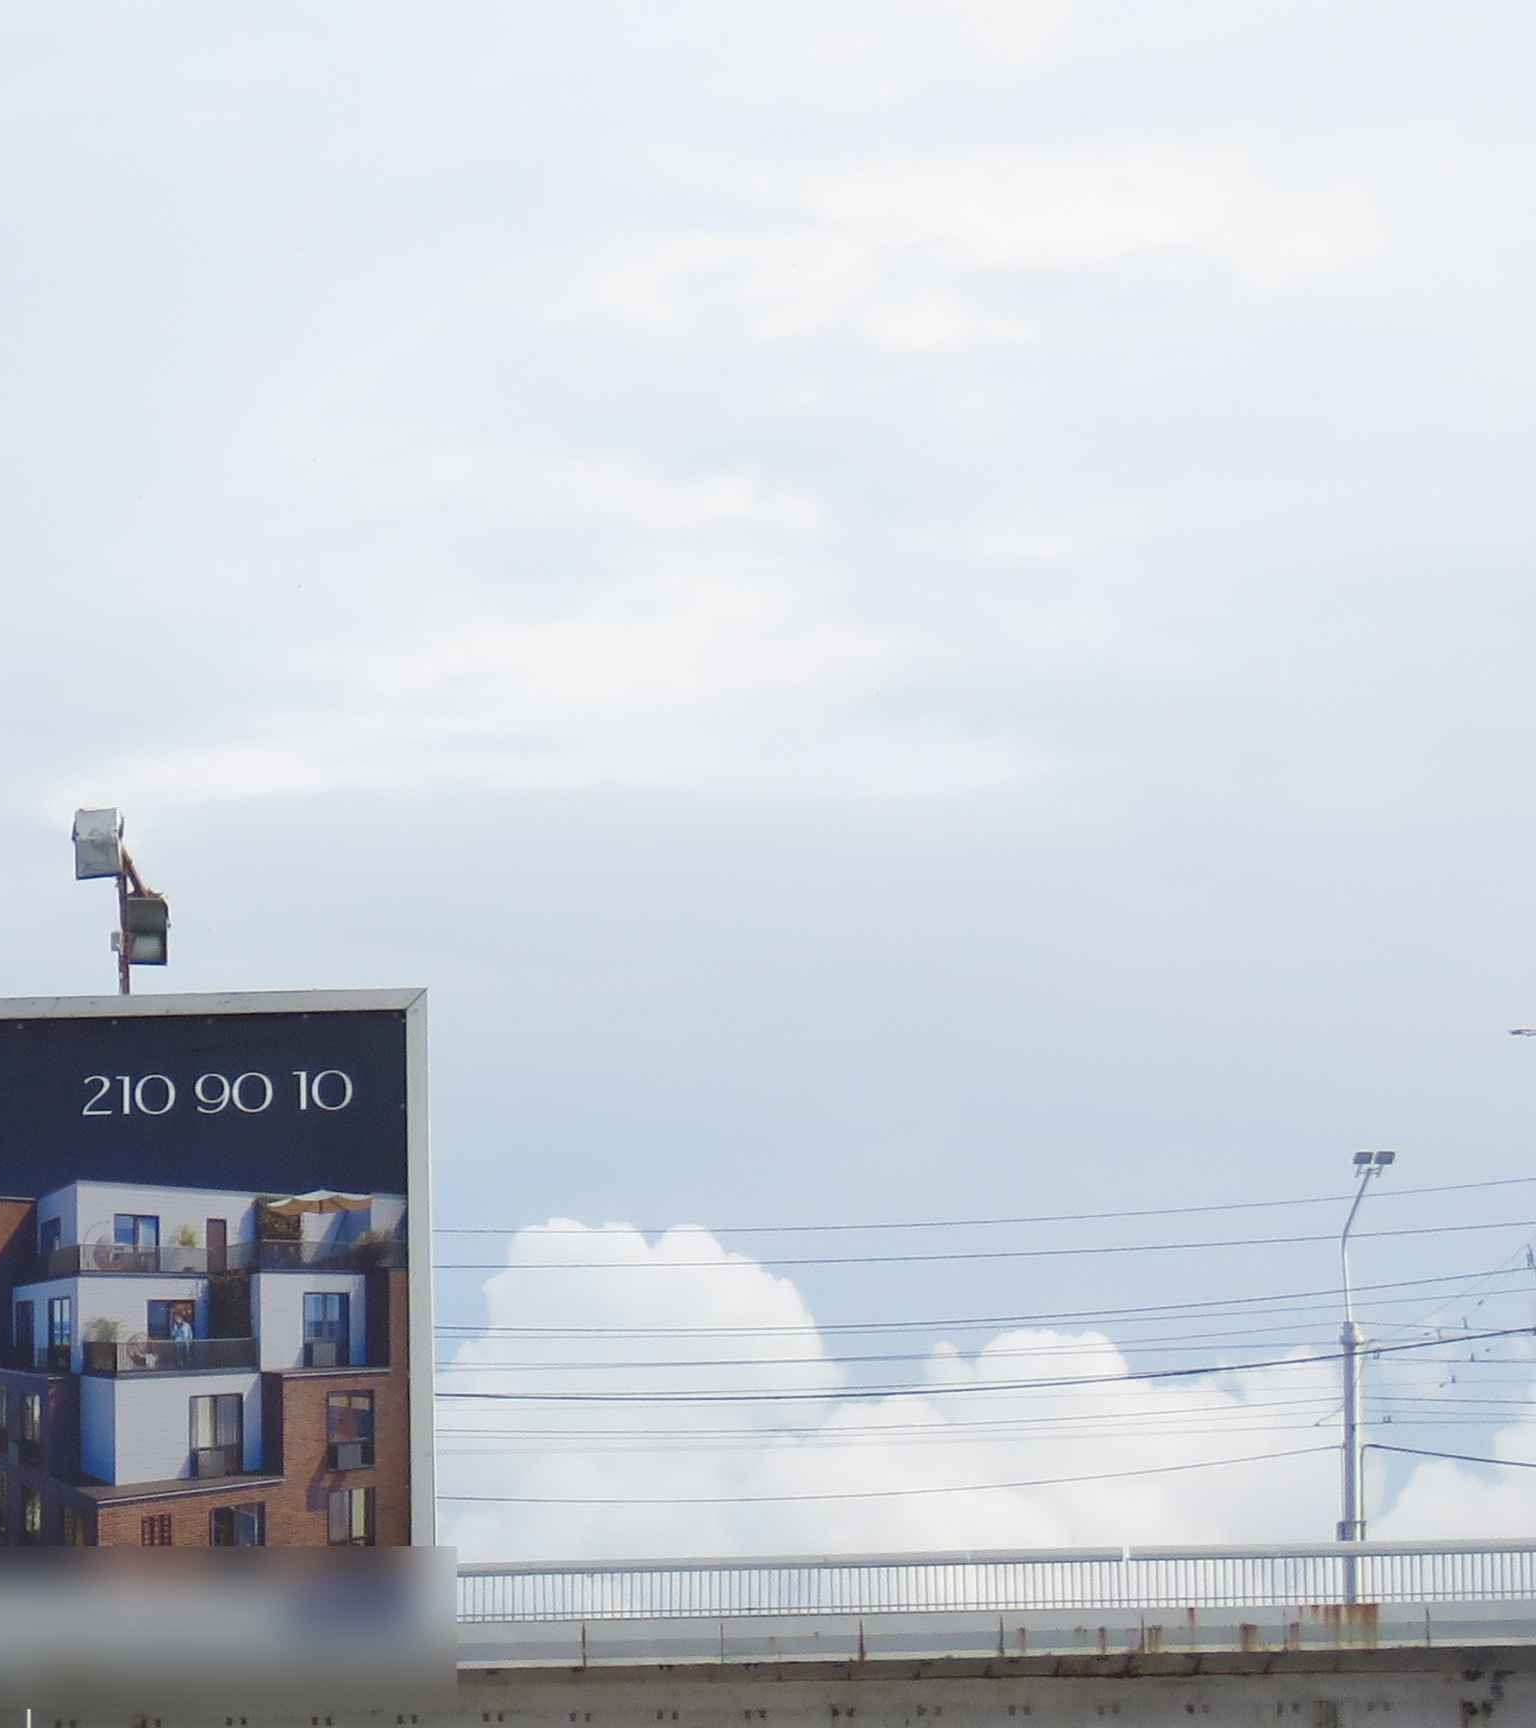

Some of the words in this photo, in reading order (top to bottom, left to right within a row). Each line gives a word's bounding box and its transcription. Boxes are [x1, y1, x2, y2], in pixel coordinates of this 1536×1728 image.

[81, 1074, 176, 1116] 210
[194, 1072, 273, 1114] 90
[292, 1069, 354, 1112] 10
